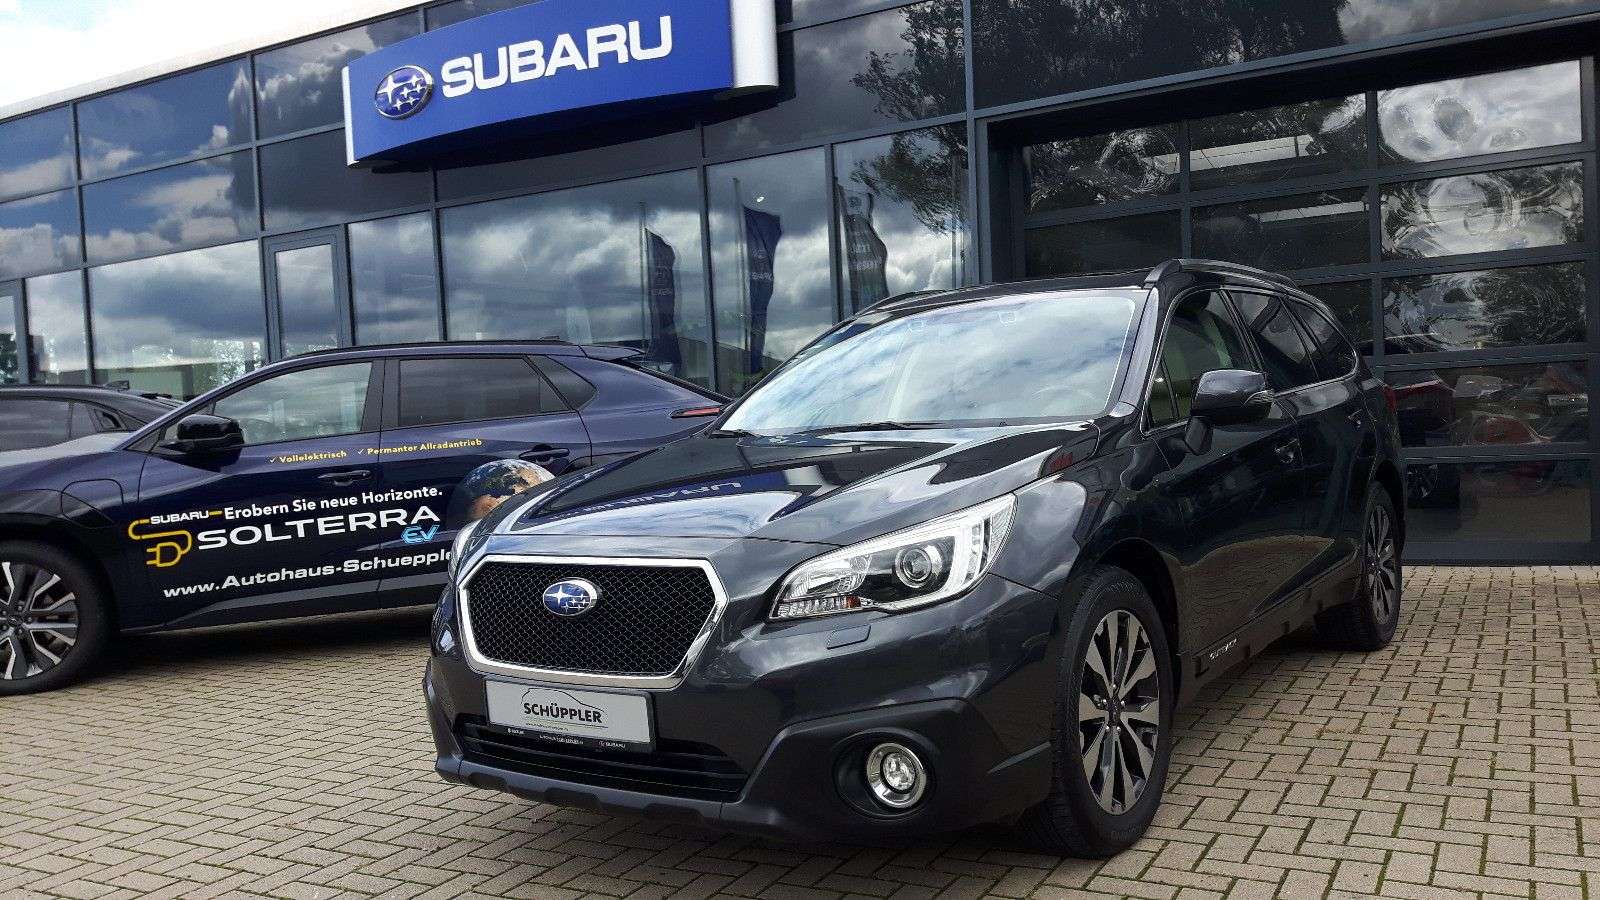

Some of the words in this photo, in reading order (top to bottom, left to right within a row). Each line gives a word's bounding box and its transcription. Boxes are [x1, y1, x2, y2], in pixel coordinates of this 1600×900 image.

[441, 15, 673, 98] SUBARU
[419, 438, 482, 451] Allradantrieb
[279, 450, 347, 463] Vollelektrisch
[223, 504, 289, 520] Erobern
[292, 498, 317, 512] Sie
[320, 496, 358, 509] neue
[362, 486, 443, 504] Horizonte.
[150, 510, 209, 525] SUBARU
[197, 505, 441, 550] SOLTERRA
[401, 524, 440, 544] EV
[523, 702, 603, 723] SCHÜPPLER
